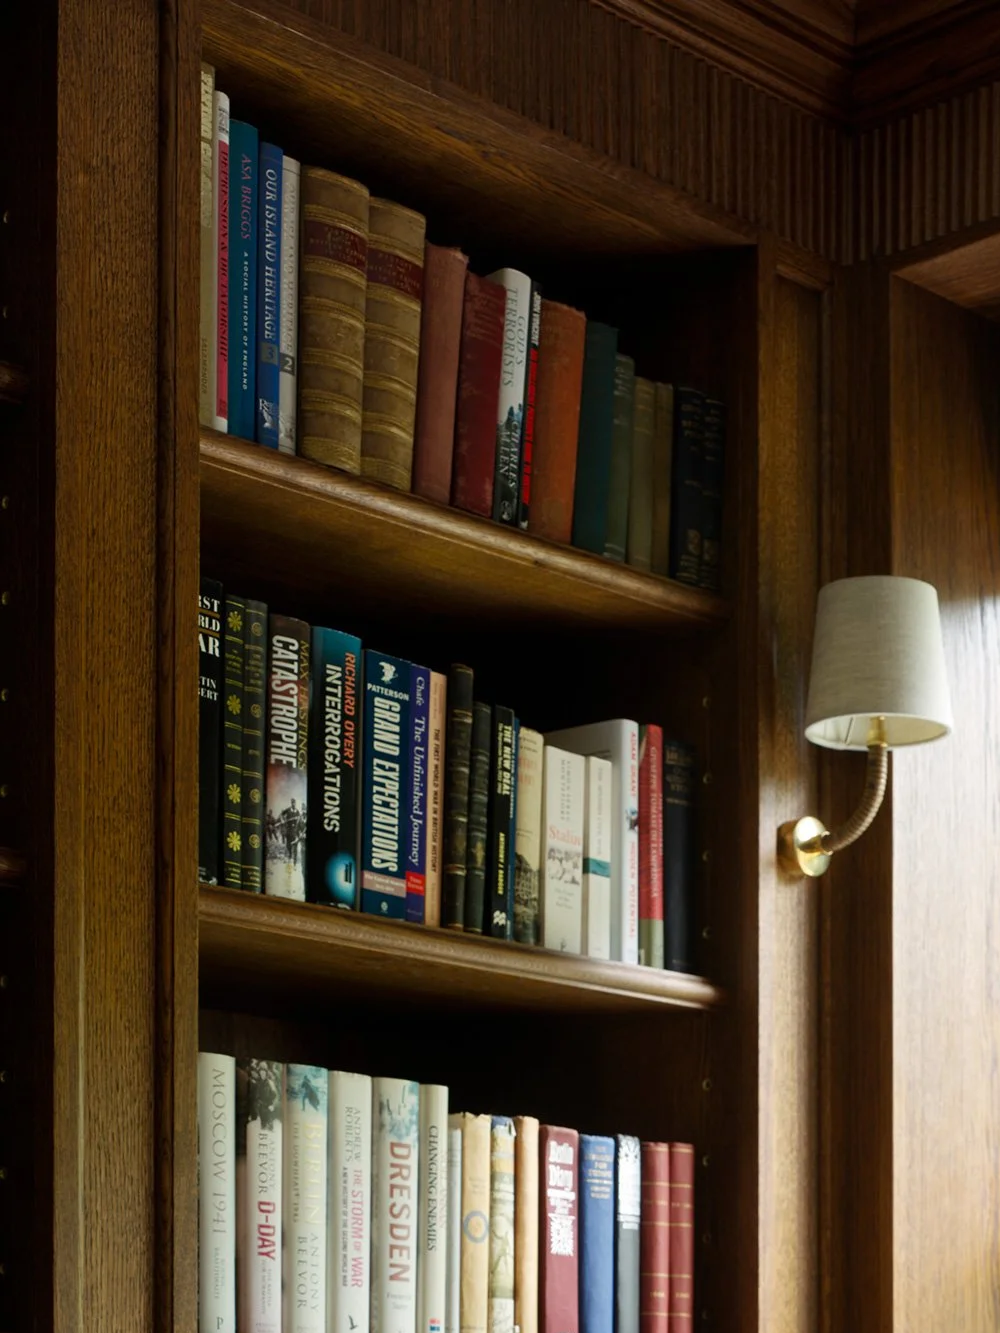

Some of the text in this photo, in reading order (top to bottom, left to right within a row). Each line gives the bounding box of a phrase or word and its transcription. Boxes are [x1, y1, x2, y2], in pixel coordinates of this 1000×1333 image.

[241, 153, 252, 240] ASA BRIGGS
[263, 168, 278, 341] OUR ISLAND HERITAGE
[242, 334, 249, 346] OF
[282, 277, 295, 351] HERITAGE
[503, 286, 519, 386] TERRORISTS
[516, 314, 528, 365] GOD'S
[282, 356, 296, 373] 2
[508, 421, 522, 488] CHARLES
[269, 634, 299, 768] CATASTROPHE
[297, 639, 310, 772] MAX HASTINGS
[343, 652, 356, 769] RICHARD OVERY
[367, 682, 410, 701] PATTERSON
[415, 676, 426, 707] Chafe
[322, 663, 343, 833] INTERROGATIONS
[373, 695, 401, 756] GRAND
[414, 715, 426, 743] The
[433, 728, 441, 742] THE
[433, 742, 441, 762] FIRST
[412, 745, 426, 815] Unfinished
[432, 763, 440, 788] WORLD
[502, 724, 513, 796] THE NEW DEAL
[371, 757, 400, 873] EXPECTATIONS
[431, 816, 440, 844] BRITISH
[432, 790, 440, 806] WAR
[432, 807, 440, 816] IN
[408, 814, 423, 867] Journey
[431, 844, 439, 874] HISTORY
[212, 1068, 228, 1234] MOSCOW 1941
[258, 1132, 269, 1195] BEEVOR
[344, 1106, 355, 1162] ROBERTS
[353, 1108, 363, 1162] ANDREW
[302, 1121, 323, 1224] BERLIN
[427, 1124, 438, 1253] CHANGING ENEMIES
[257, 1200, 276, 1261] D-DAY
[351, 1169, 363, 1288] THE STORM OF WAR
[388, 1141, 412, 1284] DRESDEN
[296, 1235, 309, 1309] BEEVOR
[309, 1232, 320, 1312] ANTONY
